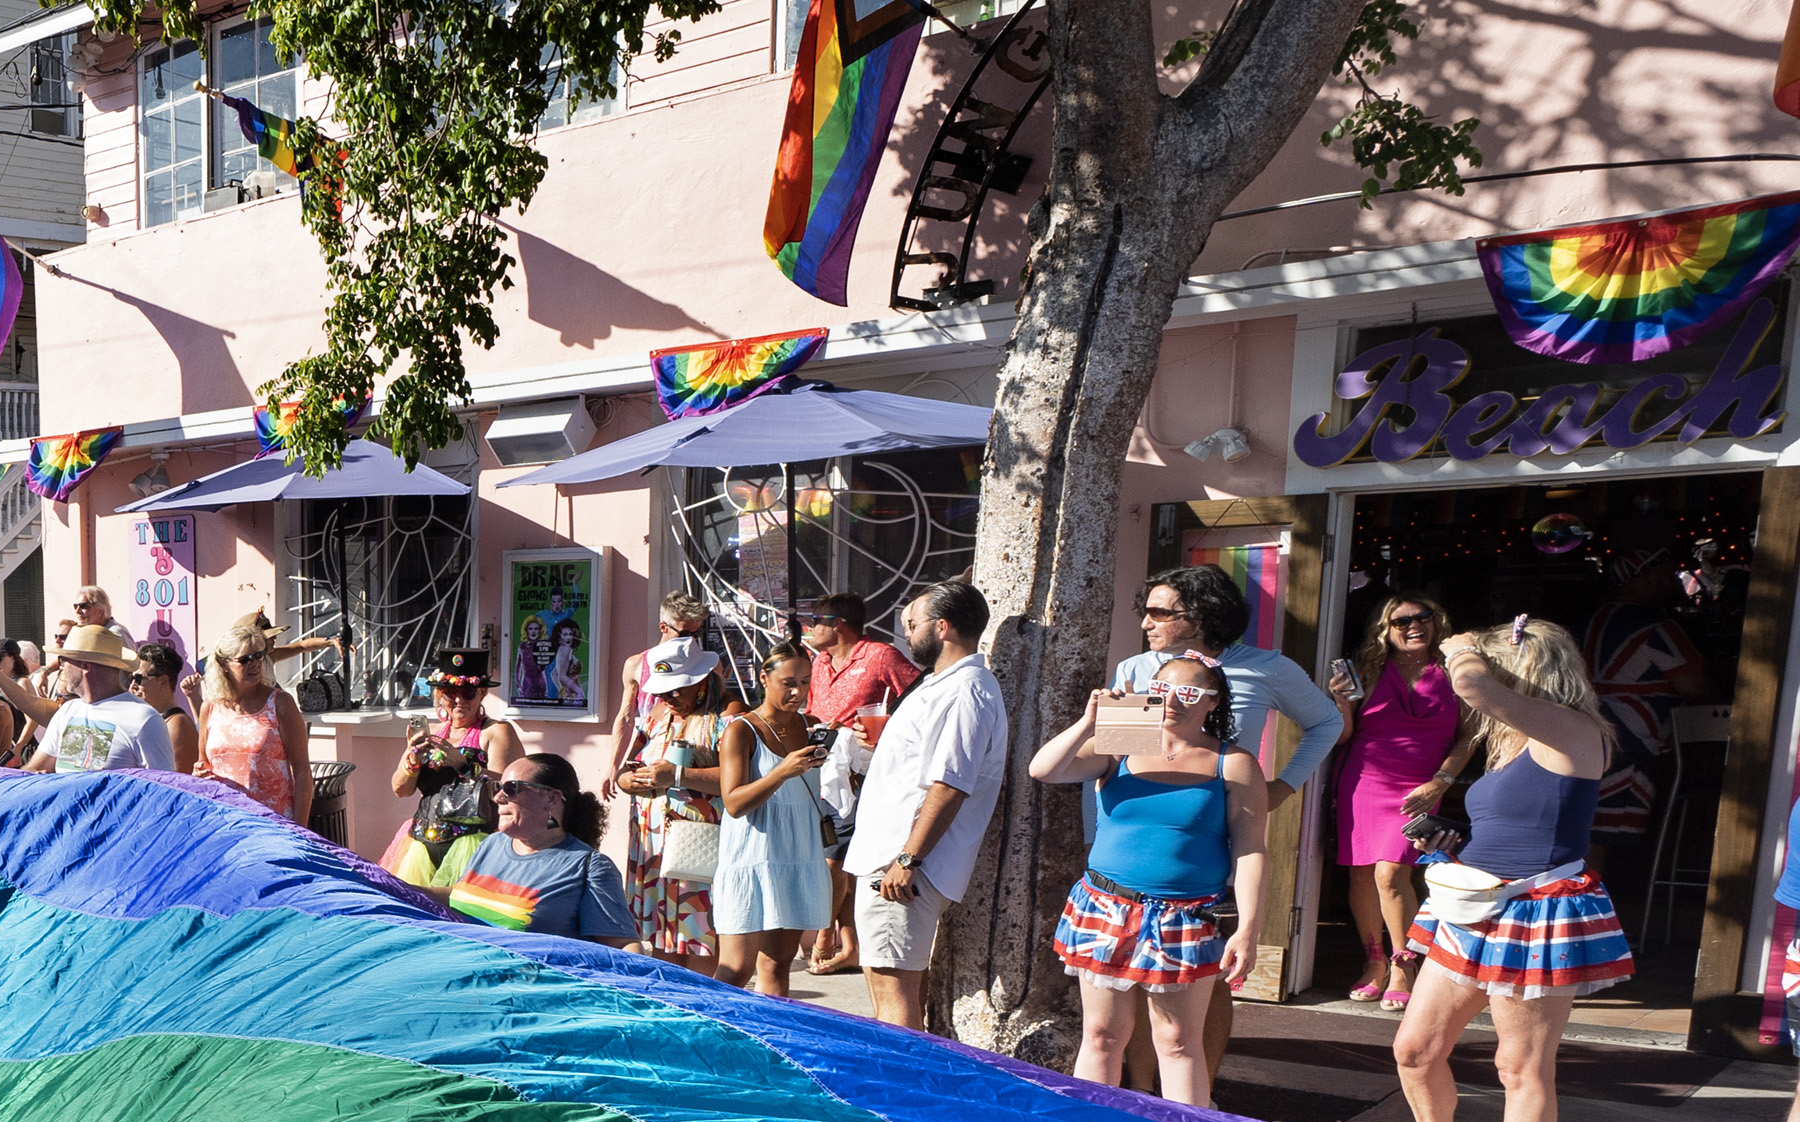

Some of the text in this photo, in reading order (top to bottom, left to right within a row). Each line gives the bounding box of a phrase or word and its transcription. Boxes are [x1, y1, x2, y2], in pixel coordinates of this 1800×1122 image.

[901, 26, 1050, 290] JUNG
[1294, 298, 1787, 467] Beach
[135, 519, 187, 545] THE
[521, 564, 576, 587] DRAG
[135, 575, 188, 607] 801
[517, 590, 548, 601] SHOWS
